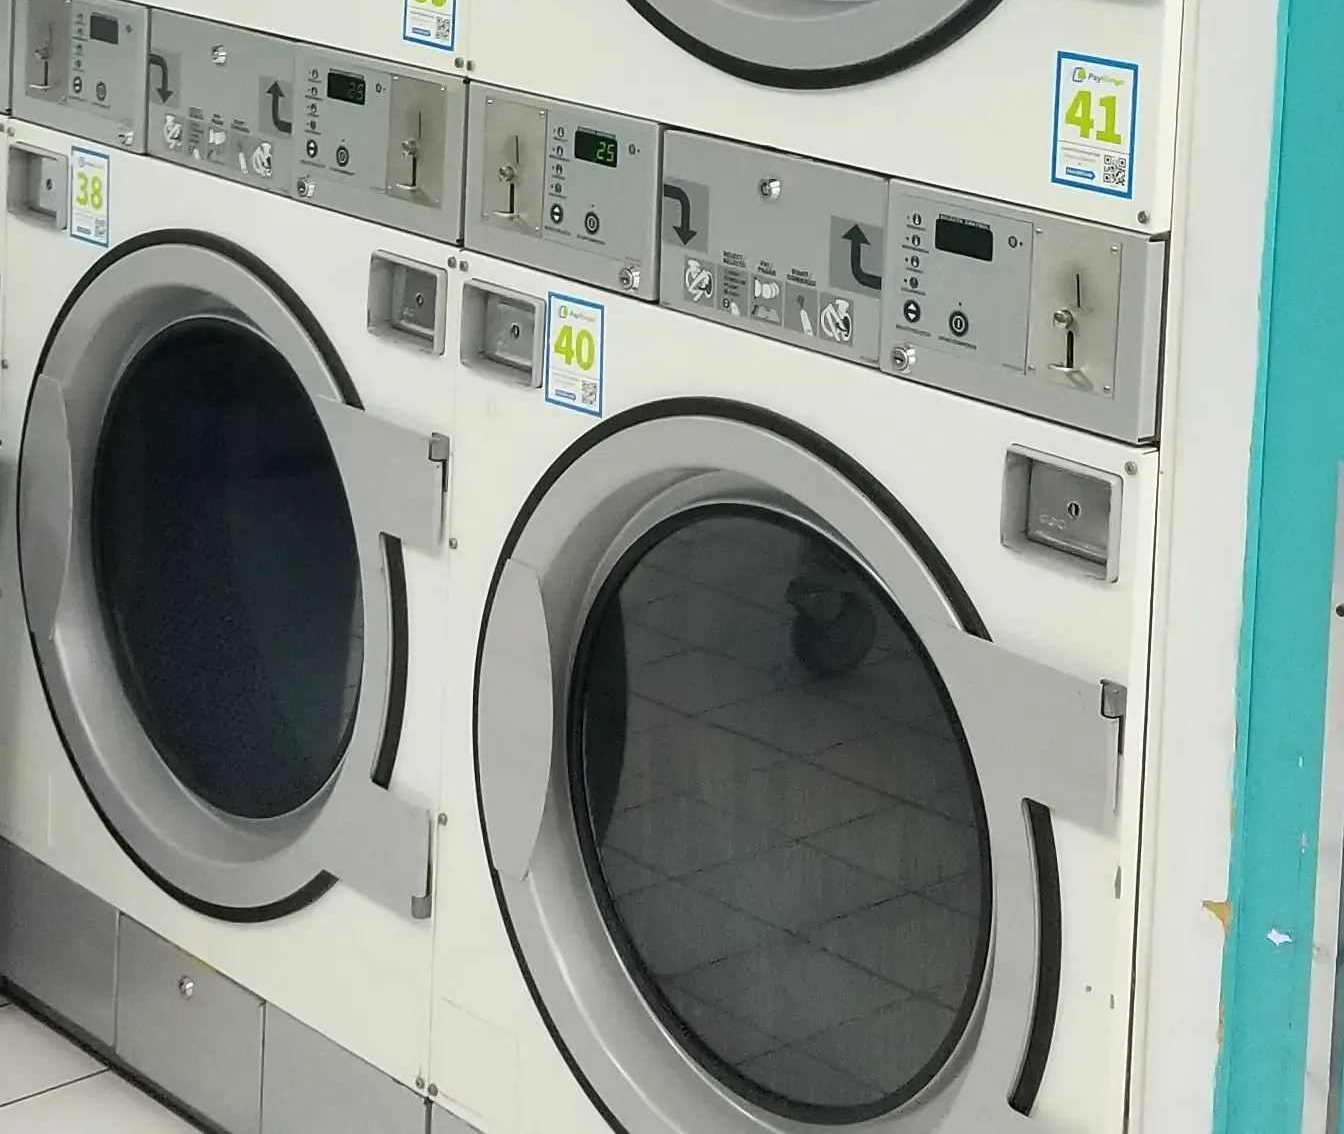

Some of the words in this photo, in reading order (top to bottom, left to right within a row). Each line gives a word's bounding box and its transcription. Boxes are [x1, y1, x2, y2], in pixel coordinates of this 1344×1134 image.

[1065, 90, 1122, 144] 41
[596, 141, 615, 162] 25
[77, 171, 104, 210] 38
[554, 324, 595, 371] 40
